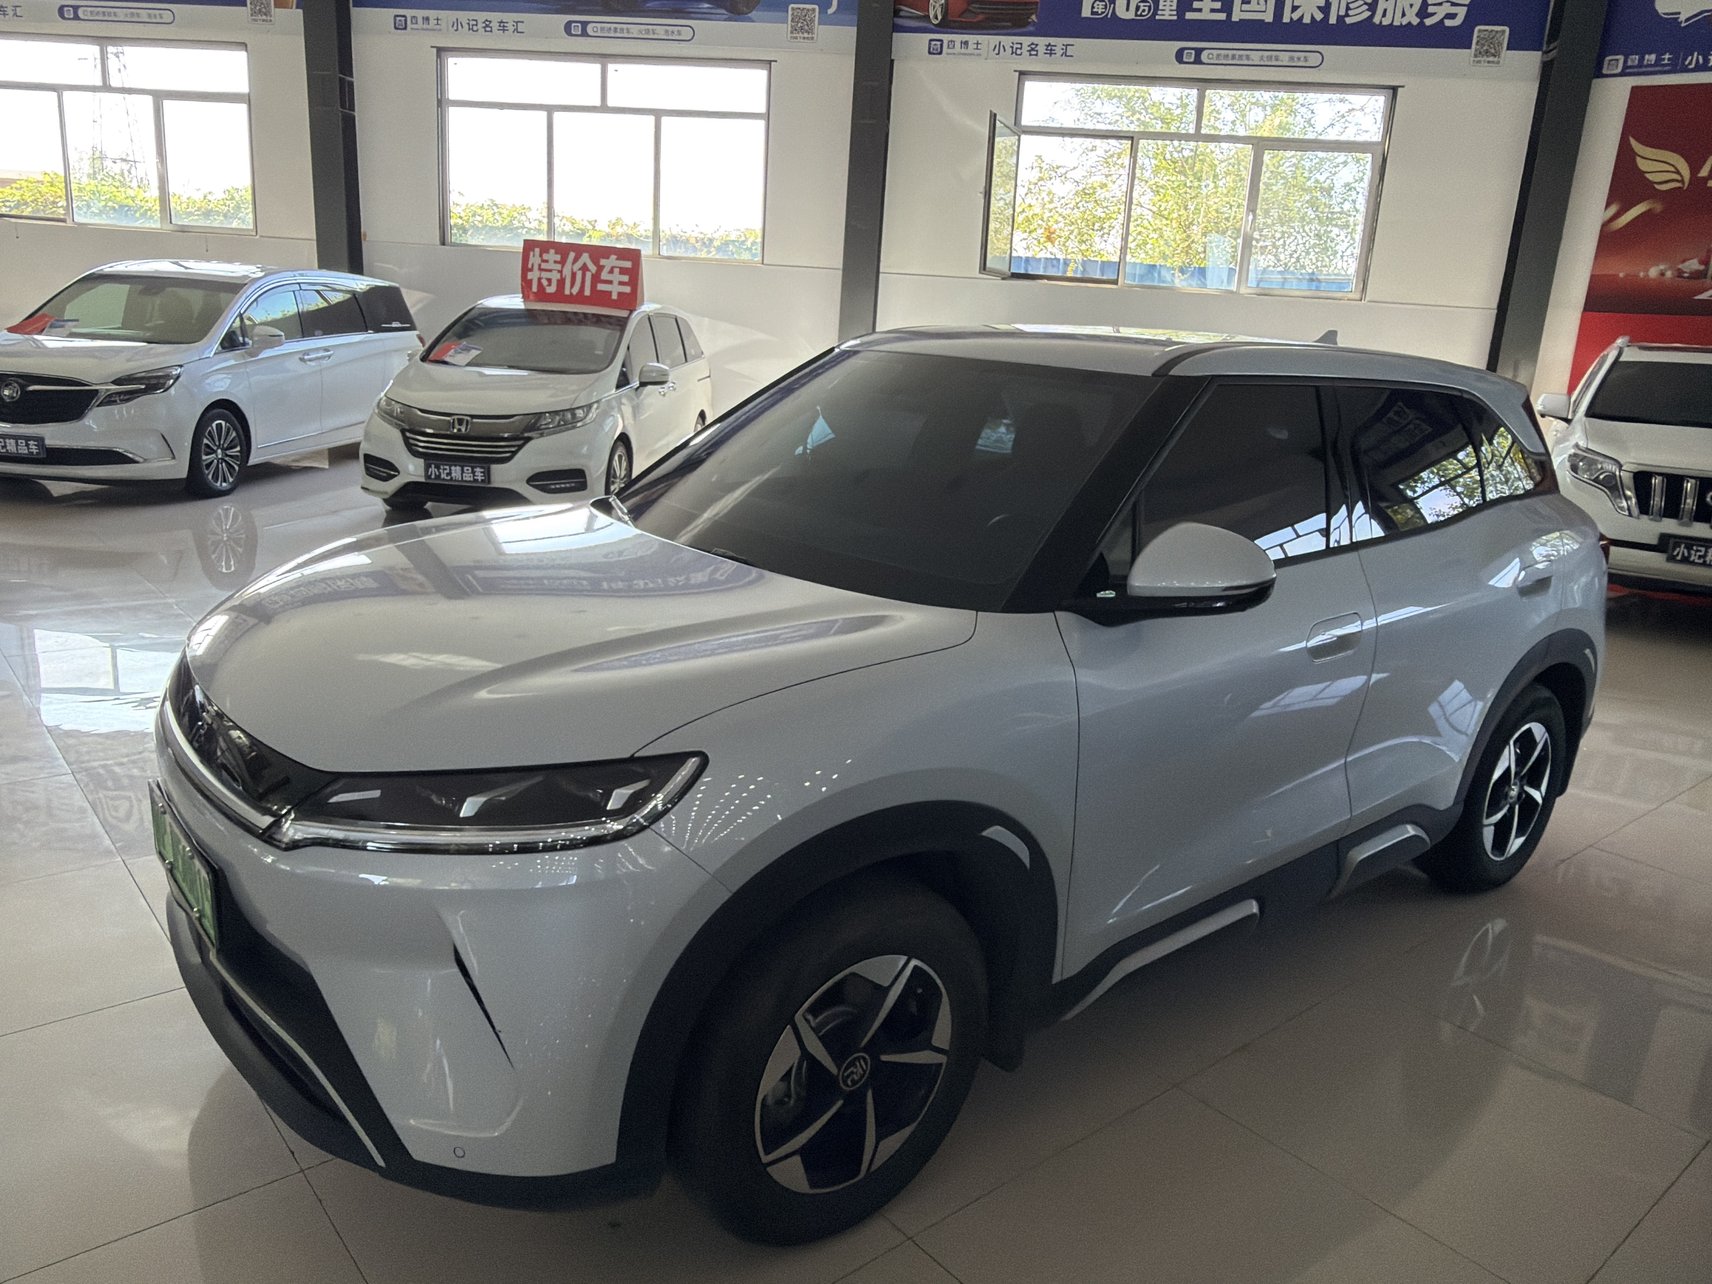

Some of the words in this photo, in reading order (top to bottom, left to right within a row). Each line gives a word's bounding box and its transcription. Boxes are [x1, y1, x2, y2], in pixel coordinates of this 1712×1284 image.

[451, 17, 525, 34] 小记名车汇
[992, 41, 1075, 58] 小记名车汇
[1685, 51, 1712, 69] 小
[527, 247, 633, 300] 特价车
[428, 464, 485, 482] 小记精品车
